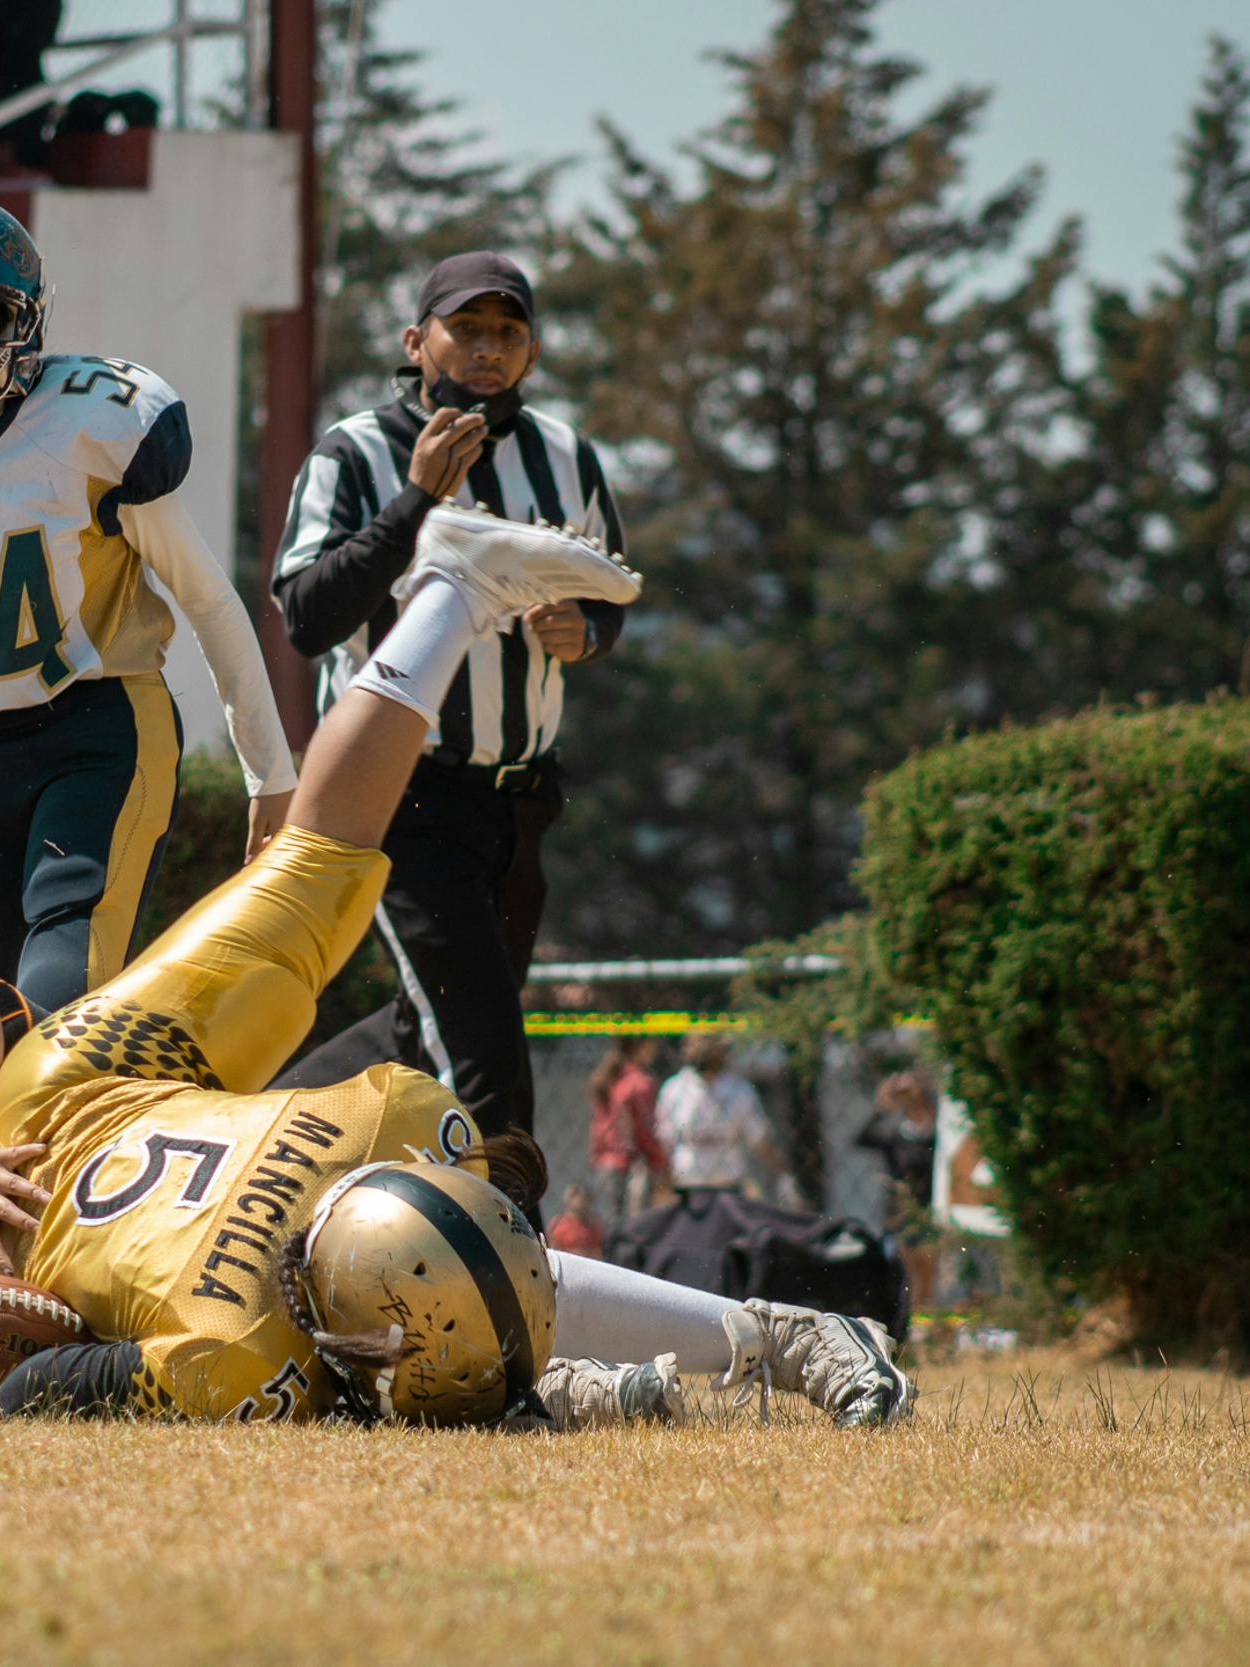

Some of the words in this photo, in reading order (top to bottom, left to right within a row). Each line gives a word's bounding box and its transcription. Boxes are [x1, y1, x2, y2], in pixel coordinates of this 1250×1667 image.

[71, 1129, 238, 1228] 5
[191, 1110, 345, 1309] MANCILLA
[234, 1355, 311, 1425] 5
